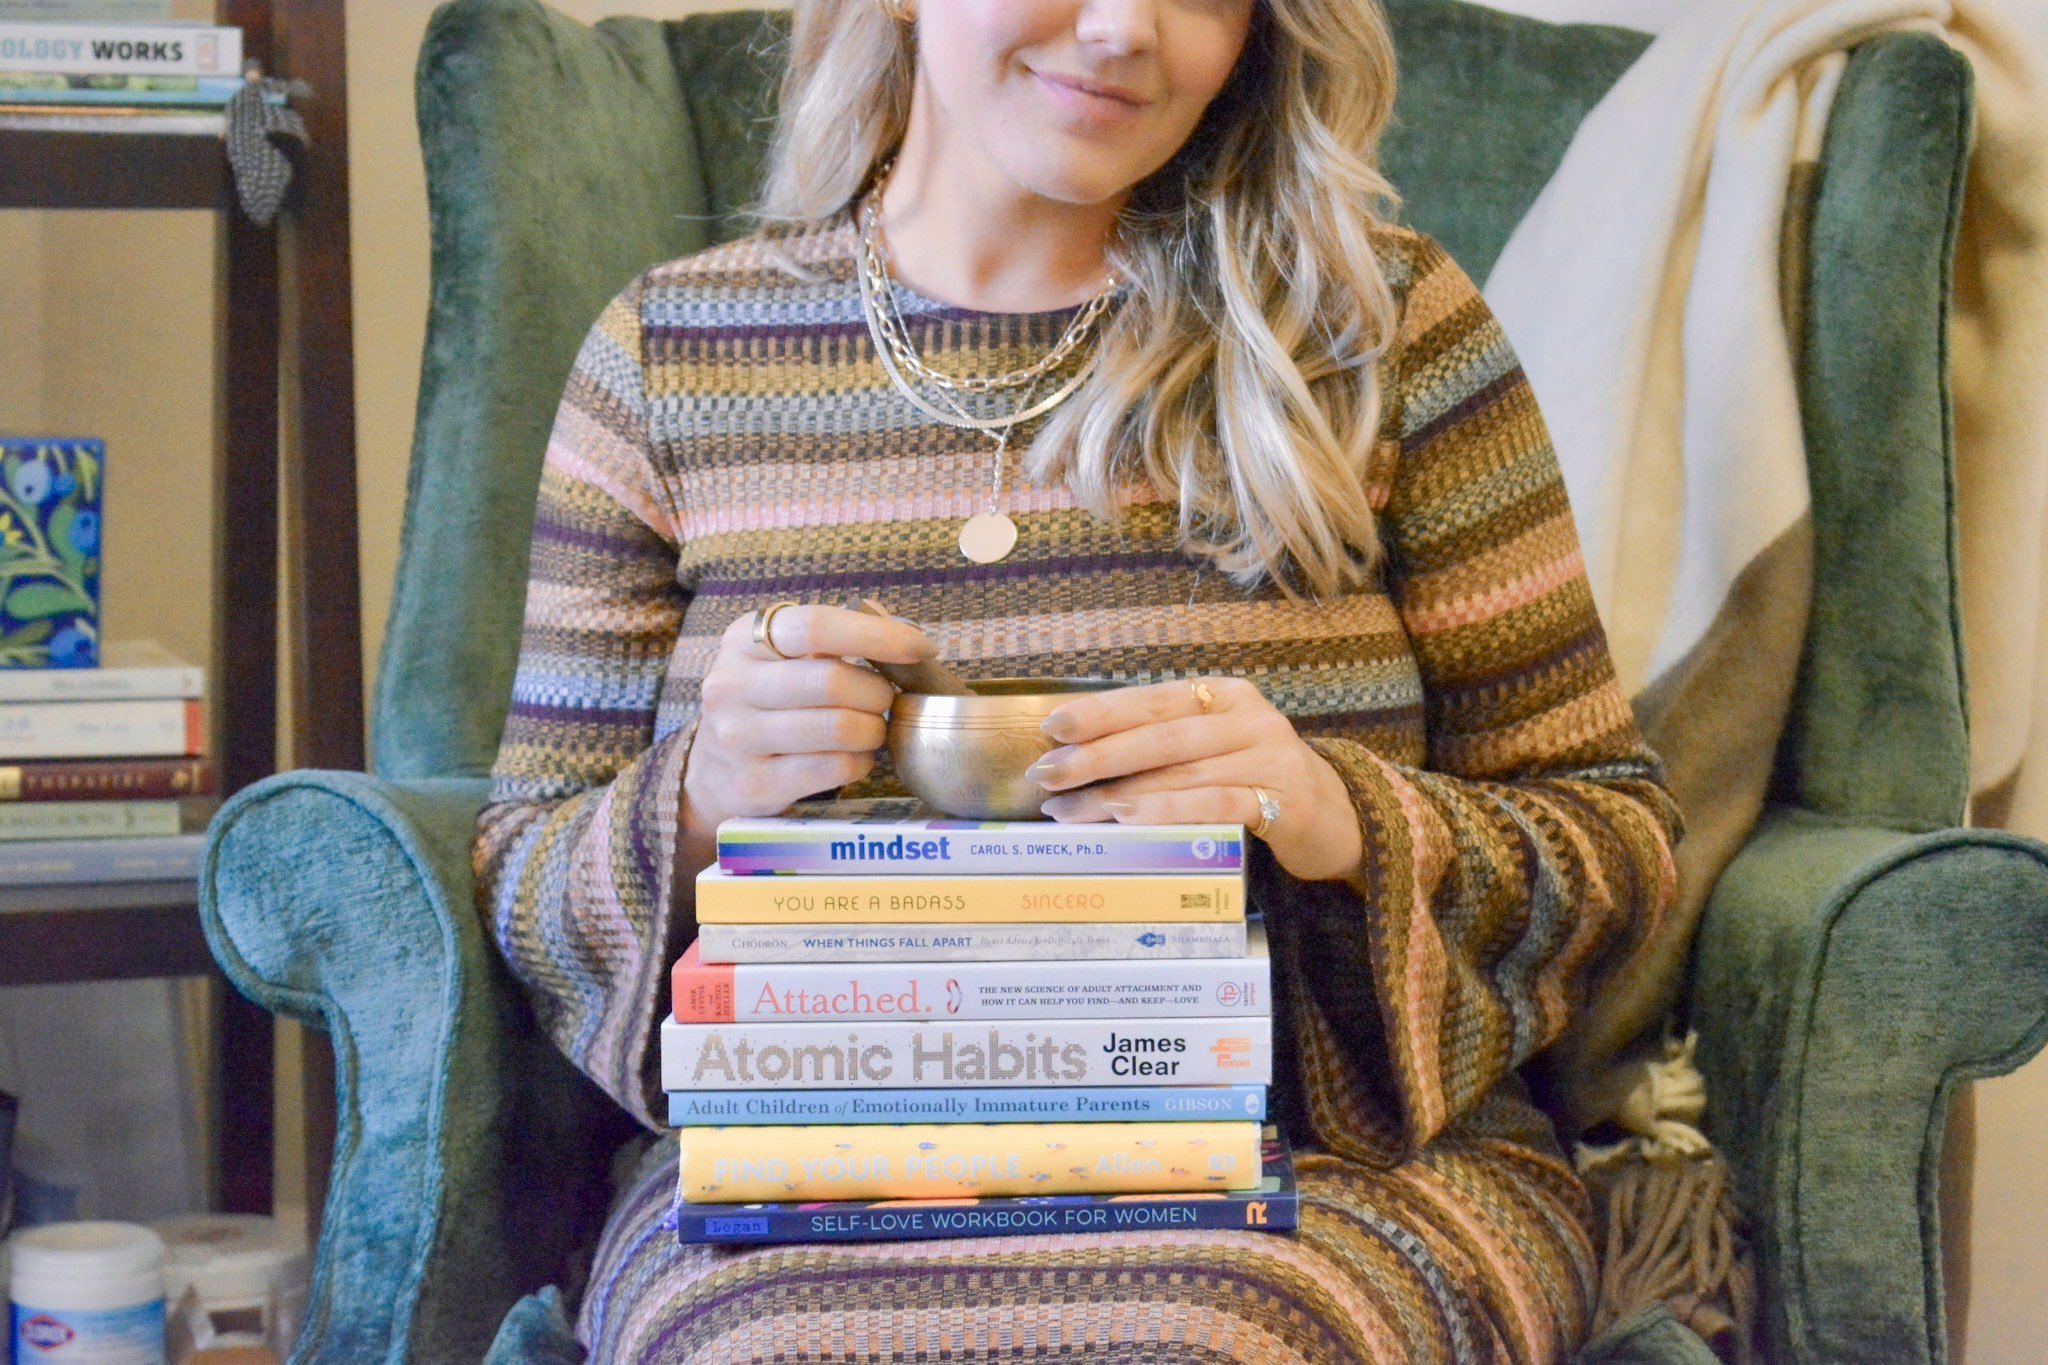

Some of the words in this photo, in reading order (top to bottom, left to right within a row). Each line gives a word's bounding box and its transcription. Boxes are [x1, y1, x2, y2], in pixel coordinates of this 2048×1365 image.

[92, 40, 183, 61] WORKS
[830, 834, 952, 861] mindset
[970, 844, 1008, 856] CAROL
[1012, 844, 1023, 856] S.
[1027, 844, 1073, 857] DWECK,
[1077, 843, 1108, 856] Ph.D.
[774, 896, 814, 911] YOU
[824, 896, 859, 911] ARE
[870, 896, 880, 910] A
[890, 895, 966, 911] BADASS
[1021, 893, 1105, 910] SINCERO
[803, 938, 843, 948] WHEN
[847, 937, 895, 948] THINGS
[899, 937, 928, 947] FALL
[932, 936, 973, 947] APART
[752, 978, 933, 1015] Attached.
[1025, 985, 1065, 993] SCIENCE
[1067, 985, 1080, 993] OF
[1082, 985, 1112, 993] ADULT
[1115, 984, 1179, 992] ATTACHMENT
[1182, 984, 1202, 992] AND
[981, 998, 1004, 1006] HOW
[1066, 997, 1085, 1005] YOU
[1103, 1032, 1187, 1054] James
[691, 1032, 894, 1082] Atomic
[912, 1028, 1088, 1081] Habits
[1110, 1055, 1181, 1076] Clear
[687, 1099, 739, 1116] Adult
[746, 1098, 830, 1115] Children
[834, 1101, 850, 1117] of
[852, 1097, 968, 1118] Emotionally
[974, 1097, 1070, 1113] Immature
[1076, 1095, 1151, 1112] Parents
[1165, 1097, 1233, 1112] GIBSON
[714, 1158, 790, 1186] FIND
[800, 1154, 893, 1183] YOUR
[905, 1153, 1023, 1181] PEOPLE
[1093, 1151, 1162, 1175] Allen
[711, 1219, 763, 1235] Logan
[811, 1214, 923, 1232] SELF-LOVE
[931, 1209, 1058, 1230] WORKBOOK
[1064, 1207, 1107, 1226] FOR
[1113, 1206, 1198, 1224] WOMEN
